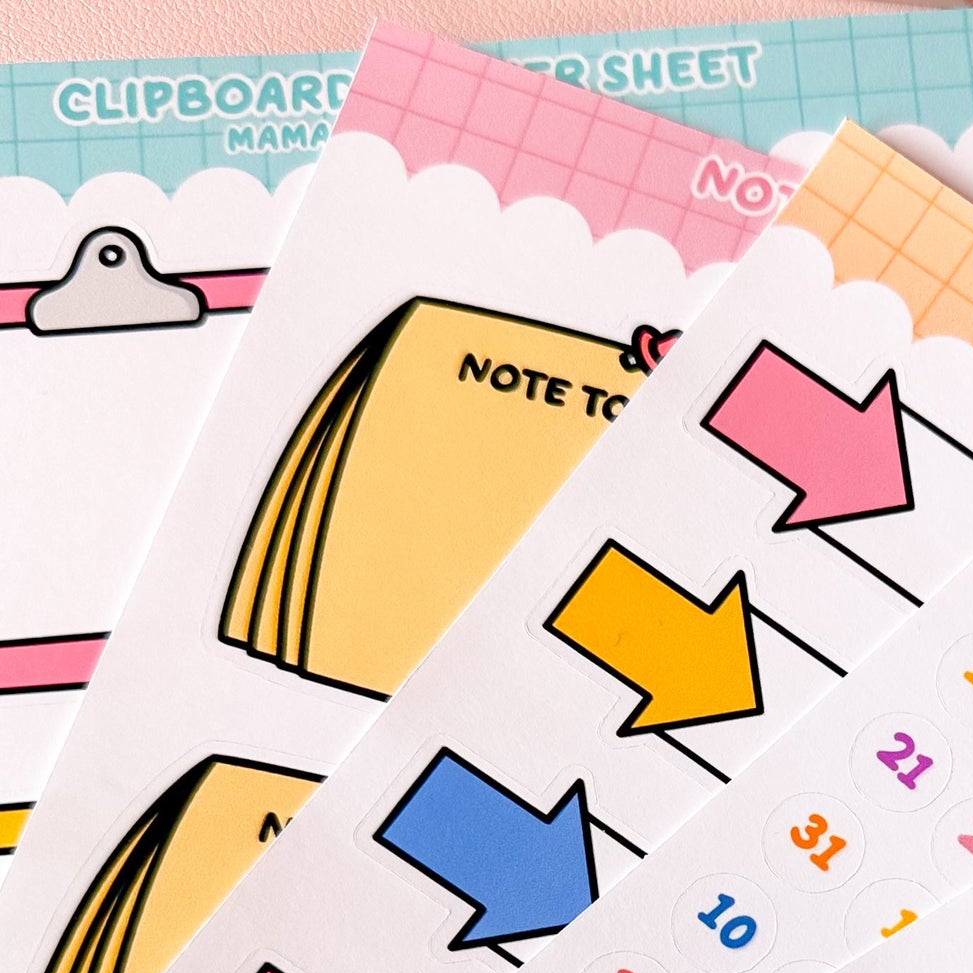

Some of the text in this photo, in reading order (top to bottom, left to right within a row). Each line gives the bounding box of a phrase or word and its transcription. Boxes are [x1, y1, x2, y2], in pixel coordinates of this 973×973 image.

[57, 73, 352, 121] CLIPBOARD
[602, 46, 758, 92] SHEET
[228, 123, 328, 152] MAMA
[696, 160, 795, 212] NO
[458, 353, 631, 423] NOTE TO
[877, 732, 933, 790] 21
[789, 813, 847, 872] 31
[698, 894, 757, 949] 10
